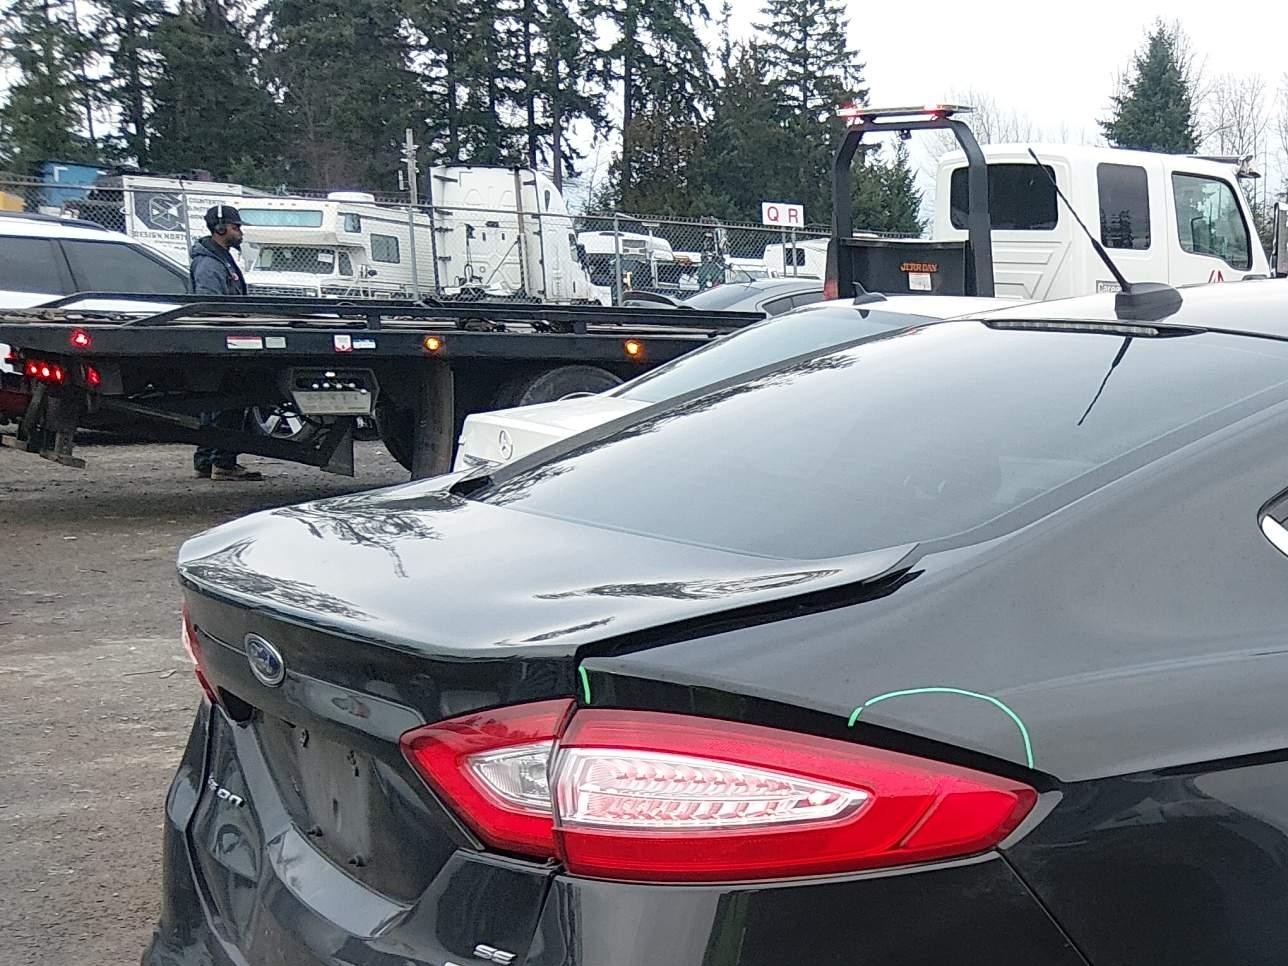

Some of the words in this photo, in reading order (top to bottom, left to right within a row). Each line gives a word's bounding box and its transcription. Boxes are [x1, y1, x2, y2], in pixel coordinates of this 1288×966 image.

[767, 206, 779, 222] Q
[788, 208, 798, 223] R
[473, 944, 517, 966] SE
